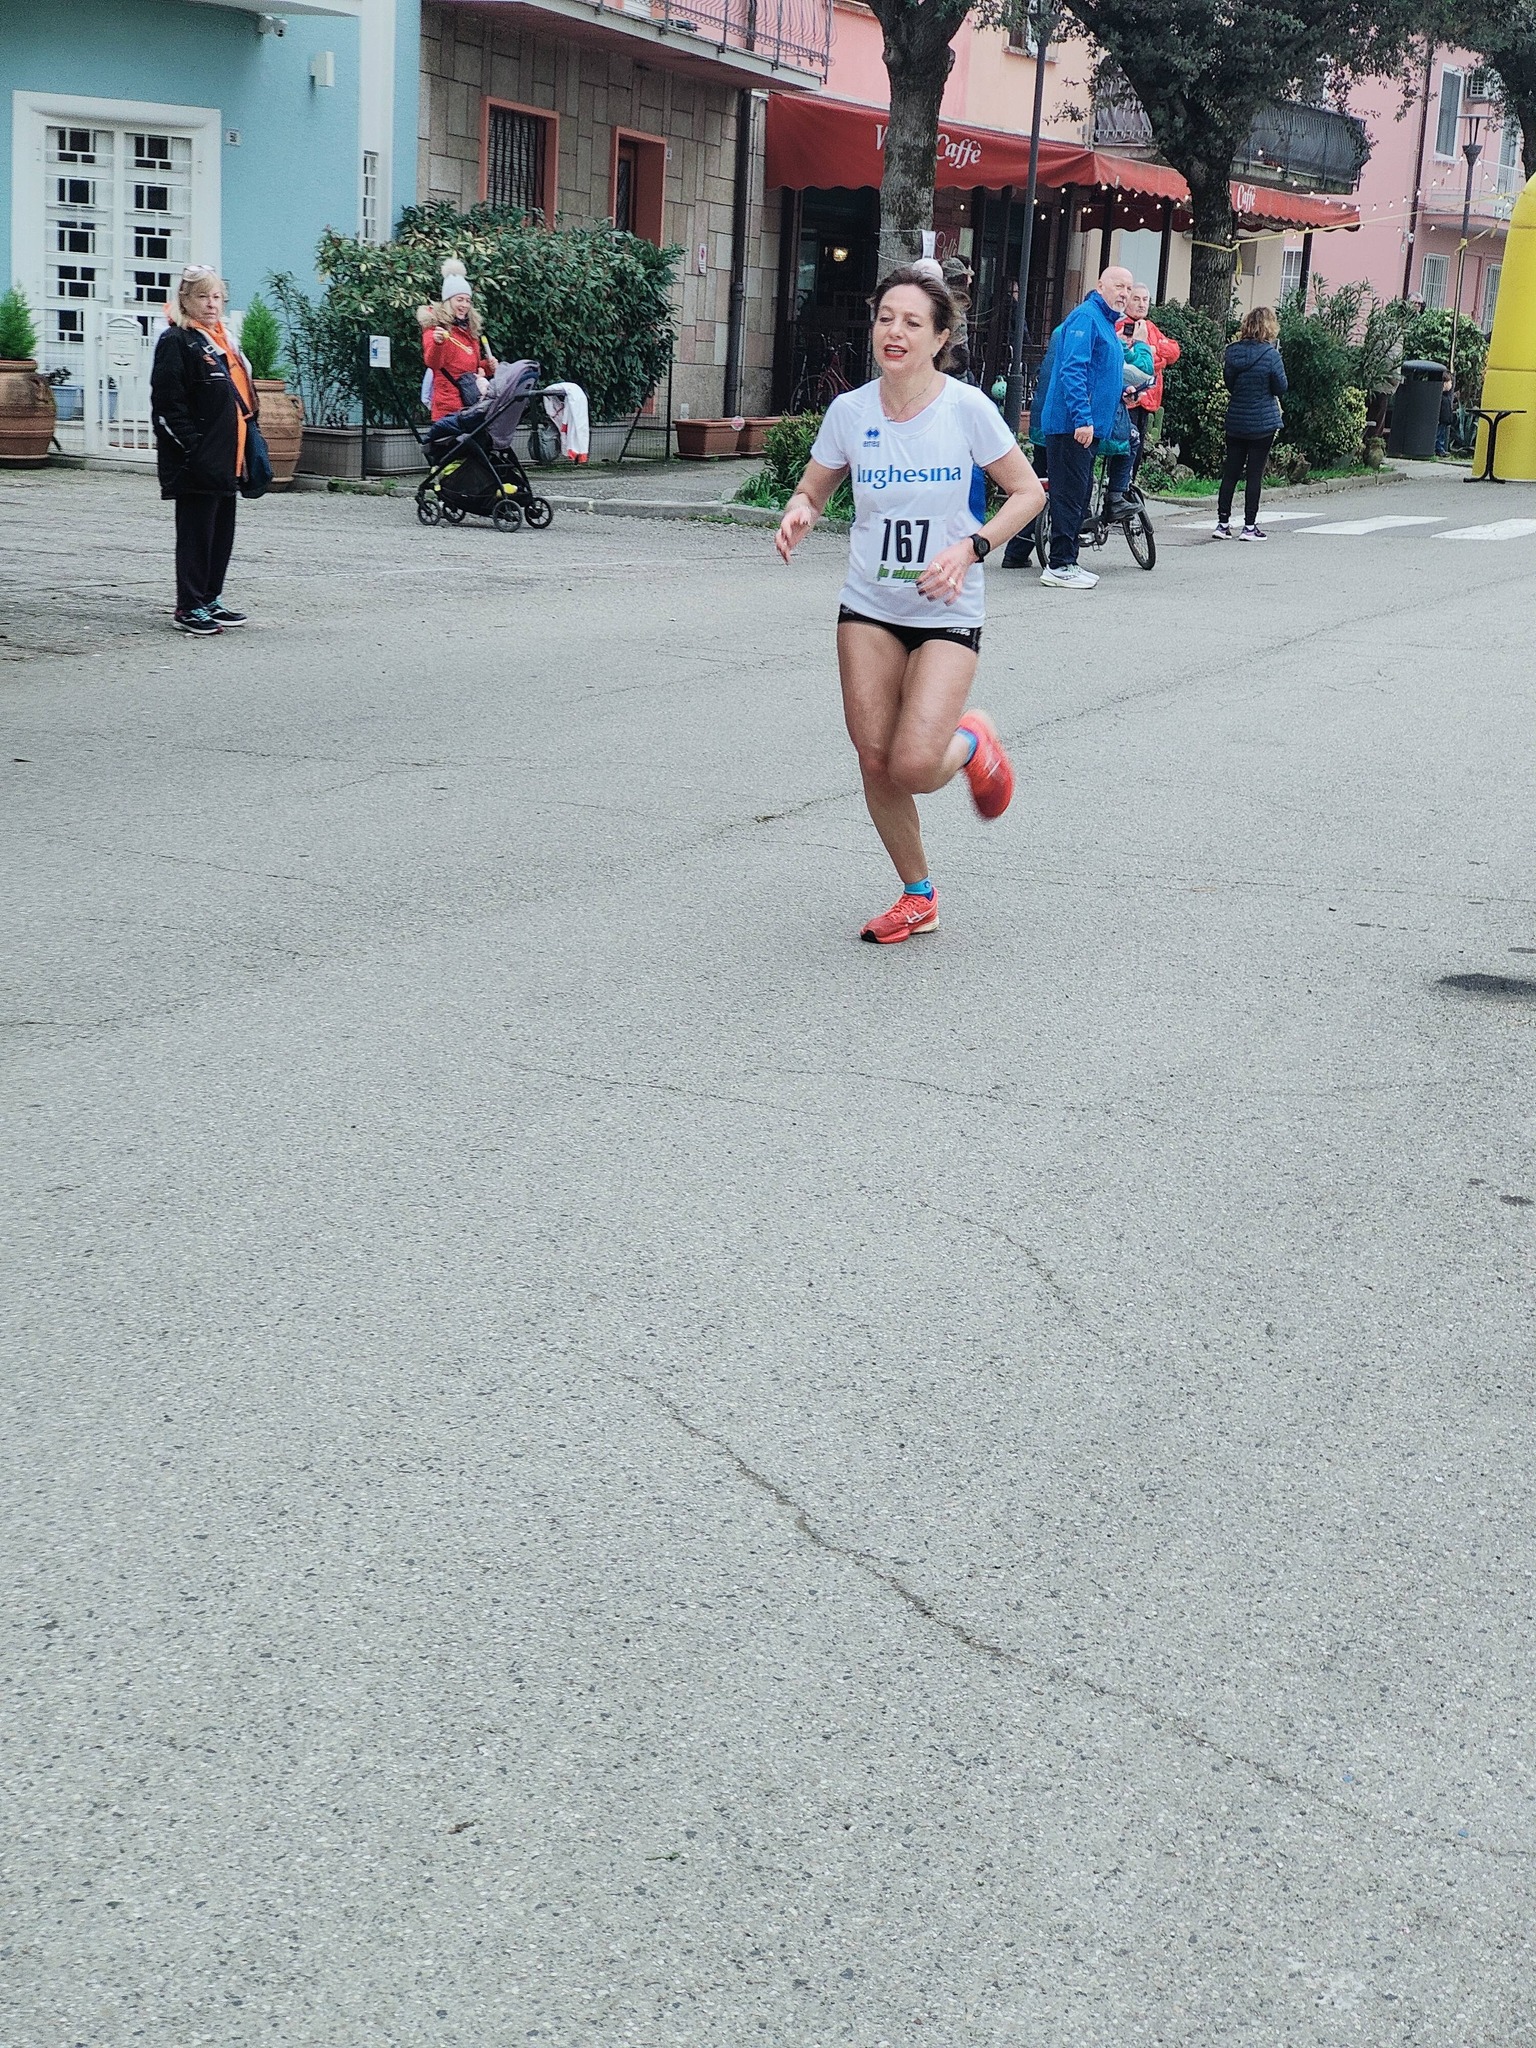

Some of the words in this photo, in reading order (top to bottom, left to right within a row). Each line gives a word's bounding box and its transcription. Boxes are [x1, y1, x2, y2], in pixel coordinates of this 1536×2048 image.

[1237, 184, 1256, 214] Caffè
[857, 463, 962, 490] lughesina
[881, 518, 930, 564] 167
